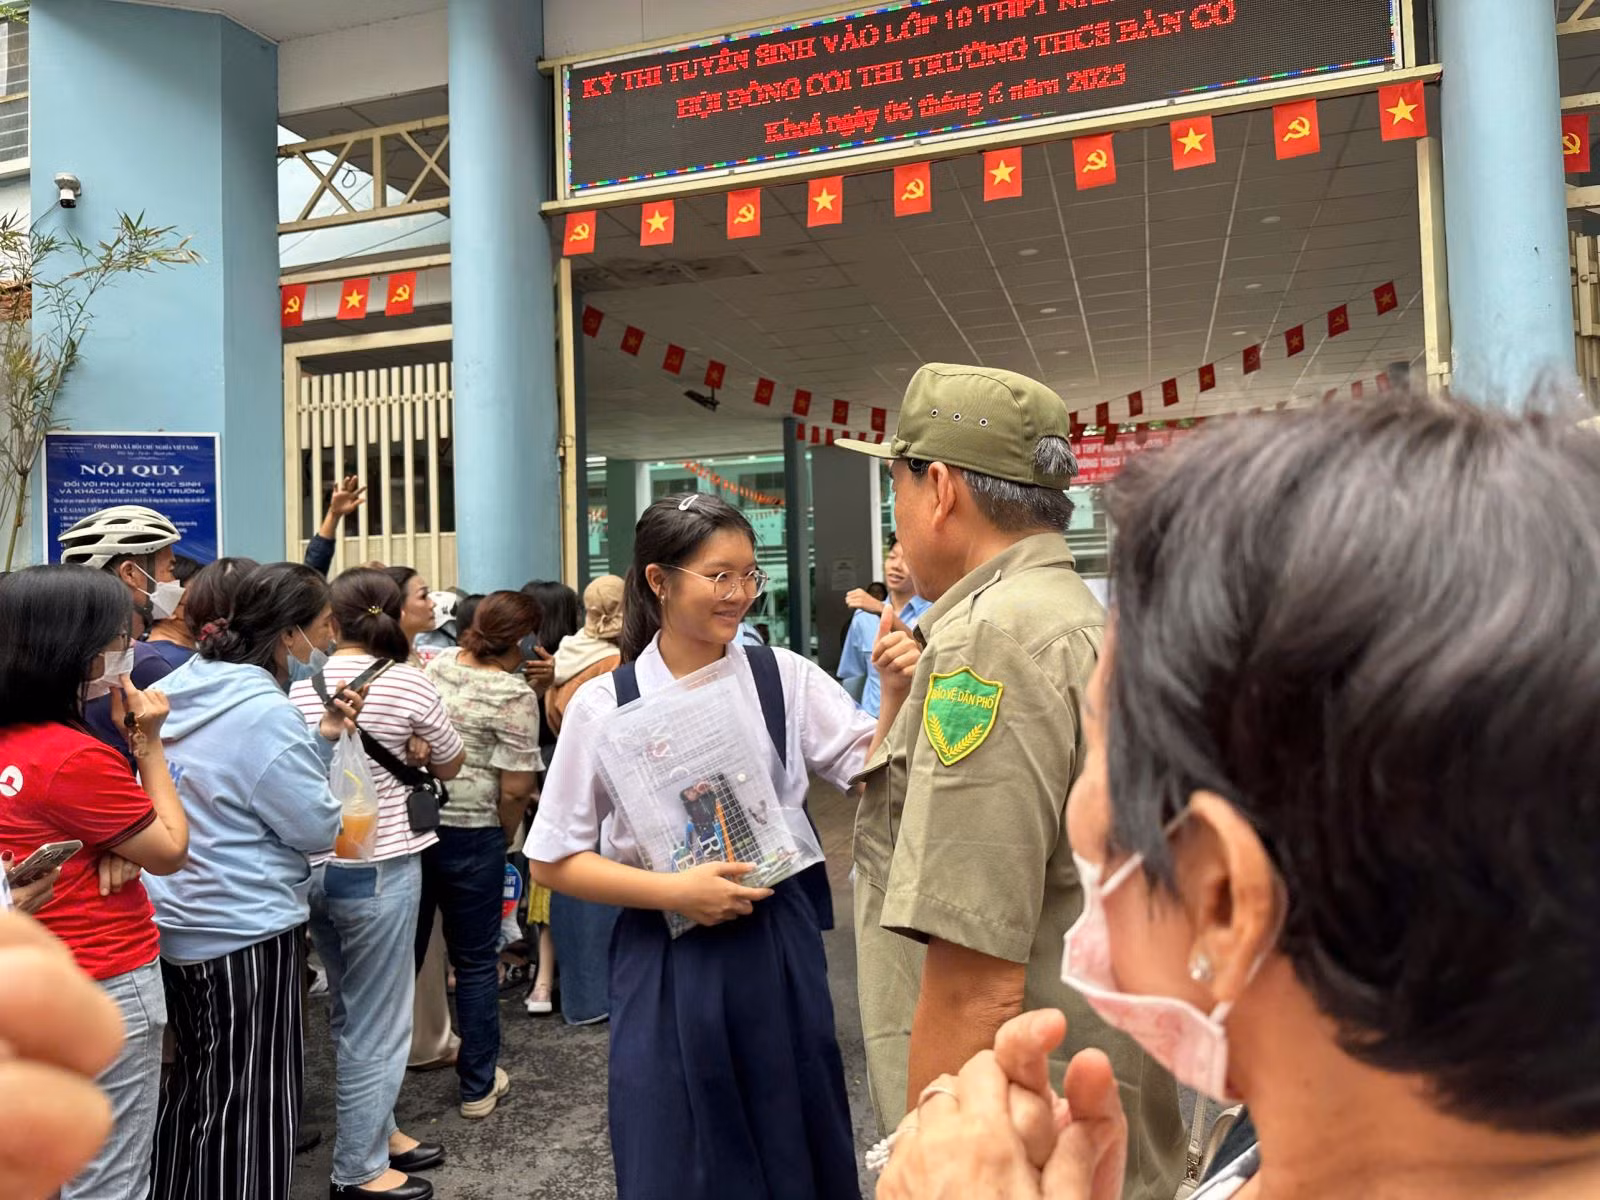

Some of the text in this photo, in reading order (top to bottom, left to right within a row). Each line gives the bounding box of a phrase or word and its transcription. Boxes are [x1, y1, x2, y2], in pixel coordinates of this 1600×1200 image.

[621, 65, 662, 91] THI
[666, 47, 750, 82] TUYỂN
[755, 37, 816, 67] SINH
[821, 23, 880, 53] VÀO
[945, 6, 972, 29] 10
[977, 0, 1047, 23] THPT
[676, 91, 723, 119] HỘI
[727, 77, 801, 110] ĐỒNG
[806, 69, 852, 97] COI
[856, 60, 903, 87] THI
[908, 35, 1029, 79] TRƯỜNG
[1033, 20, 1110, 56] THCS
[1116, 9, 1185, 43] BÀN
[826, 106, 880, 137] ngày
[918, 90, 984, 117] tháng
[1008, 78, 1059, 100] năm
[1066, 63, 1126, 93] 2025
[80, 461, 184, 478] NỘI QUY
[74, 487, 110, 495] KHÁCH
[100, 480, 119, 489] PHỤ
[958, 690, 976, 705] DÂN
[976, 694, 995, 708] PHỐ
